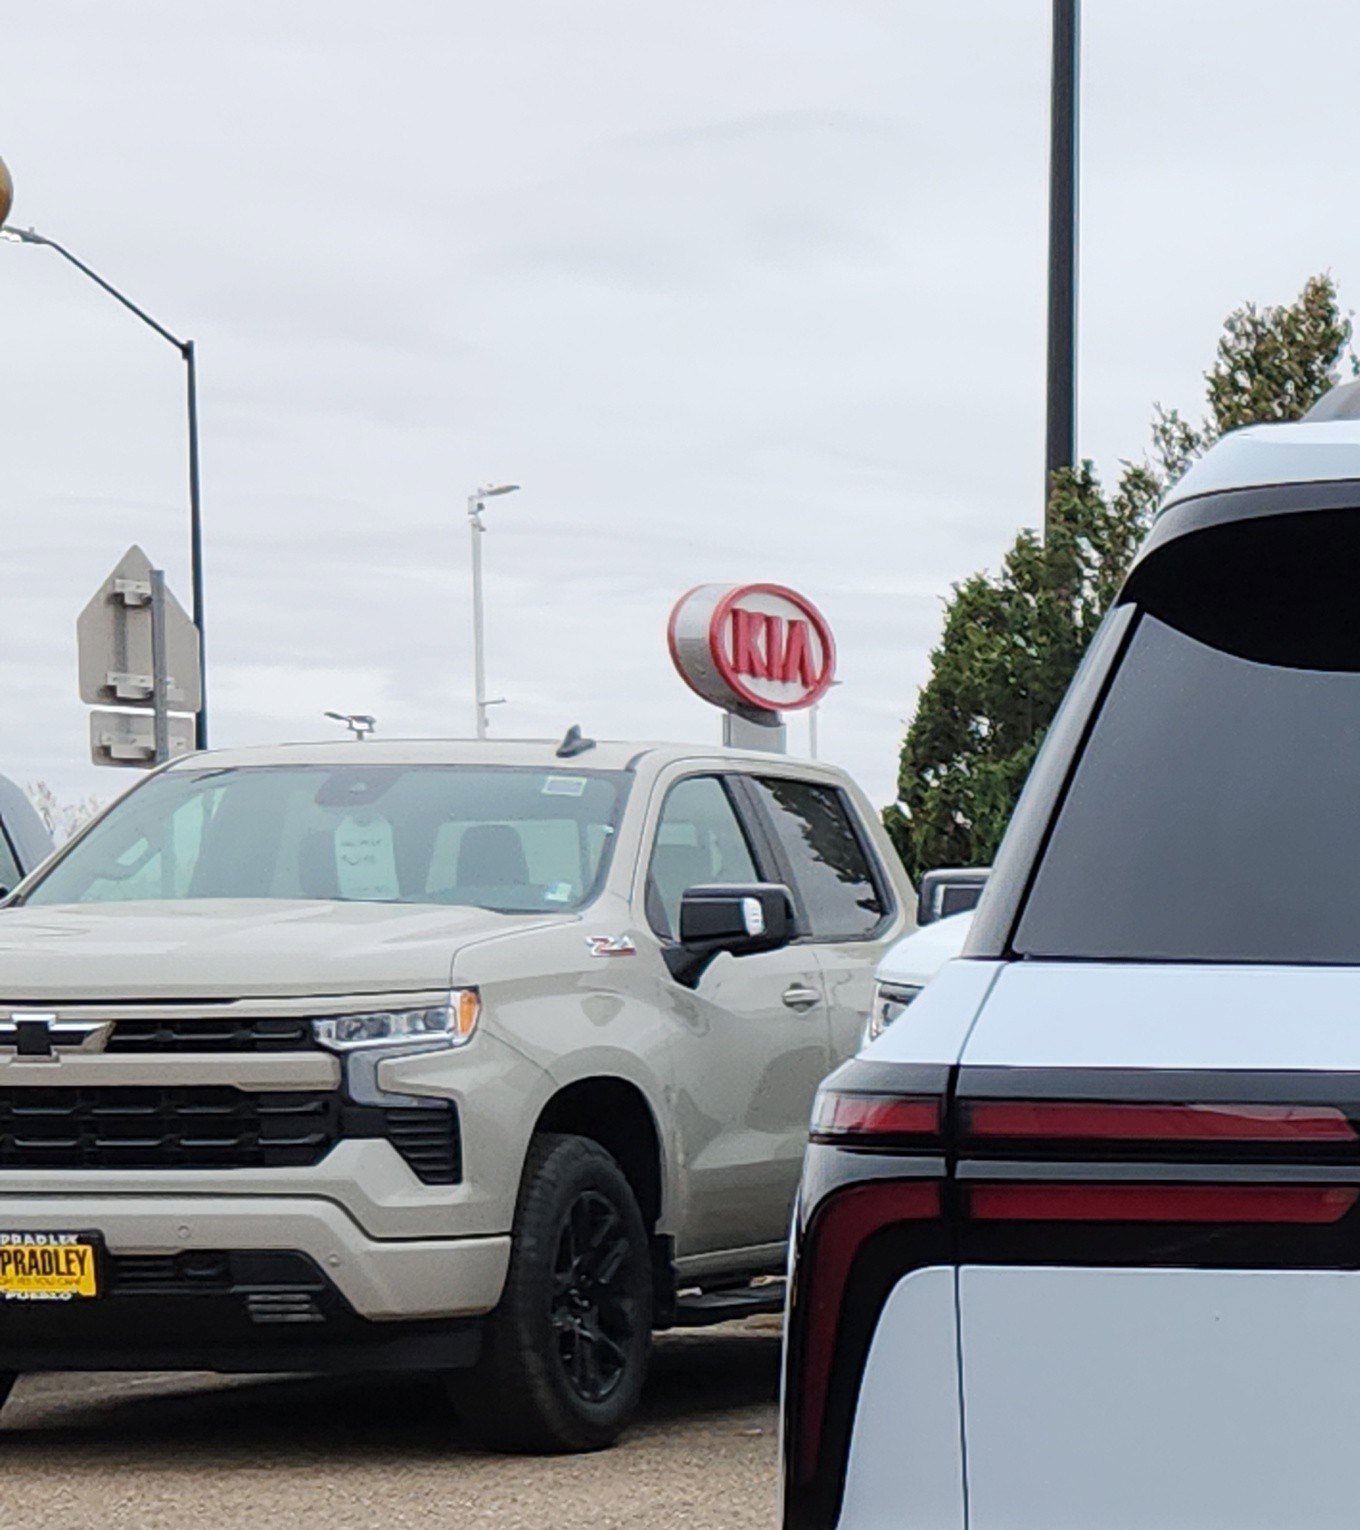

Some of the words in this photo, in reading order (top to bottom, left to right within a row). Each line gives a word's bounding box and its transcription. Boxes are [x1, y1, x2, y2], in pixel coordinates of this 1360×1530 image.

[730, 608, 818, 689] KIA
[0, 1233, 79, 1246] PRADLEY
[0, 1248, 88, 1276] PRADLEY
